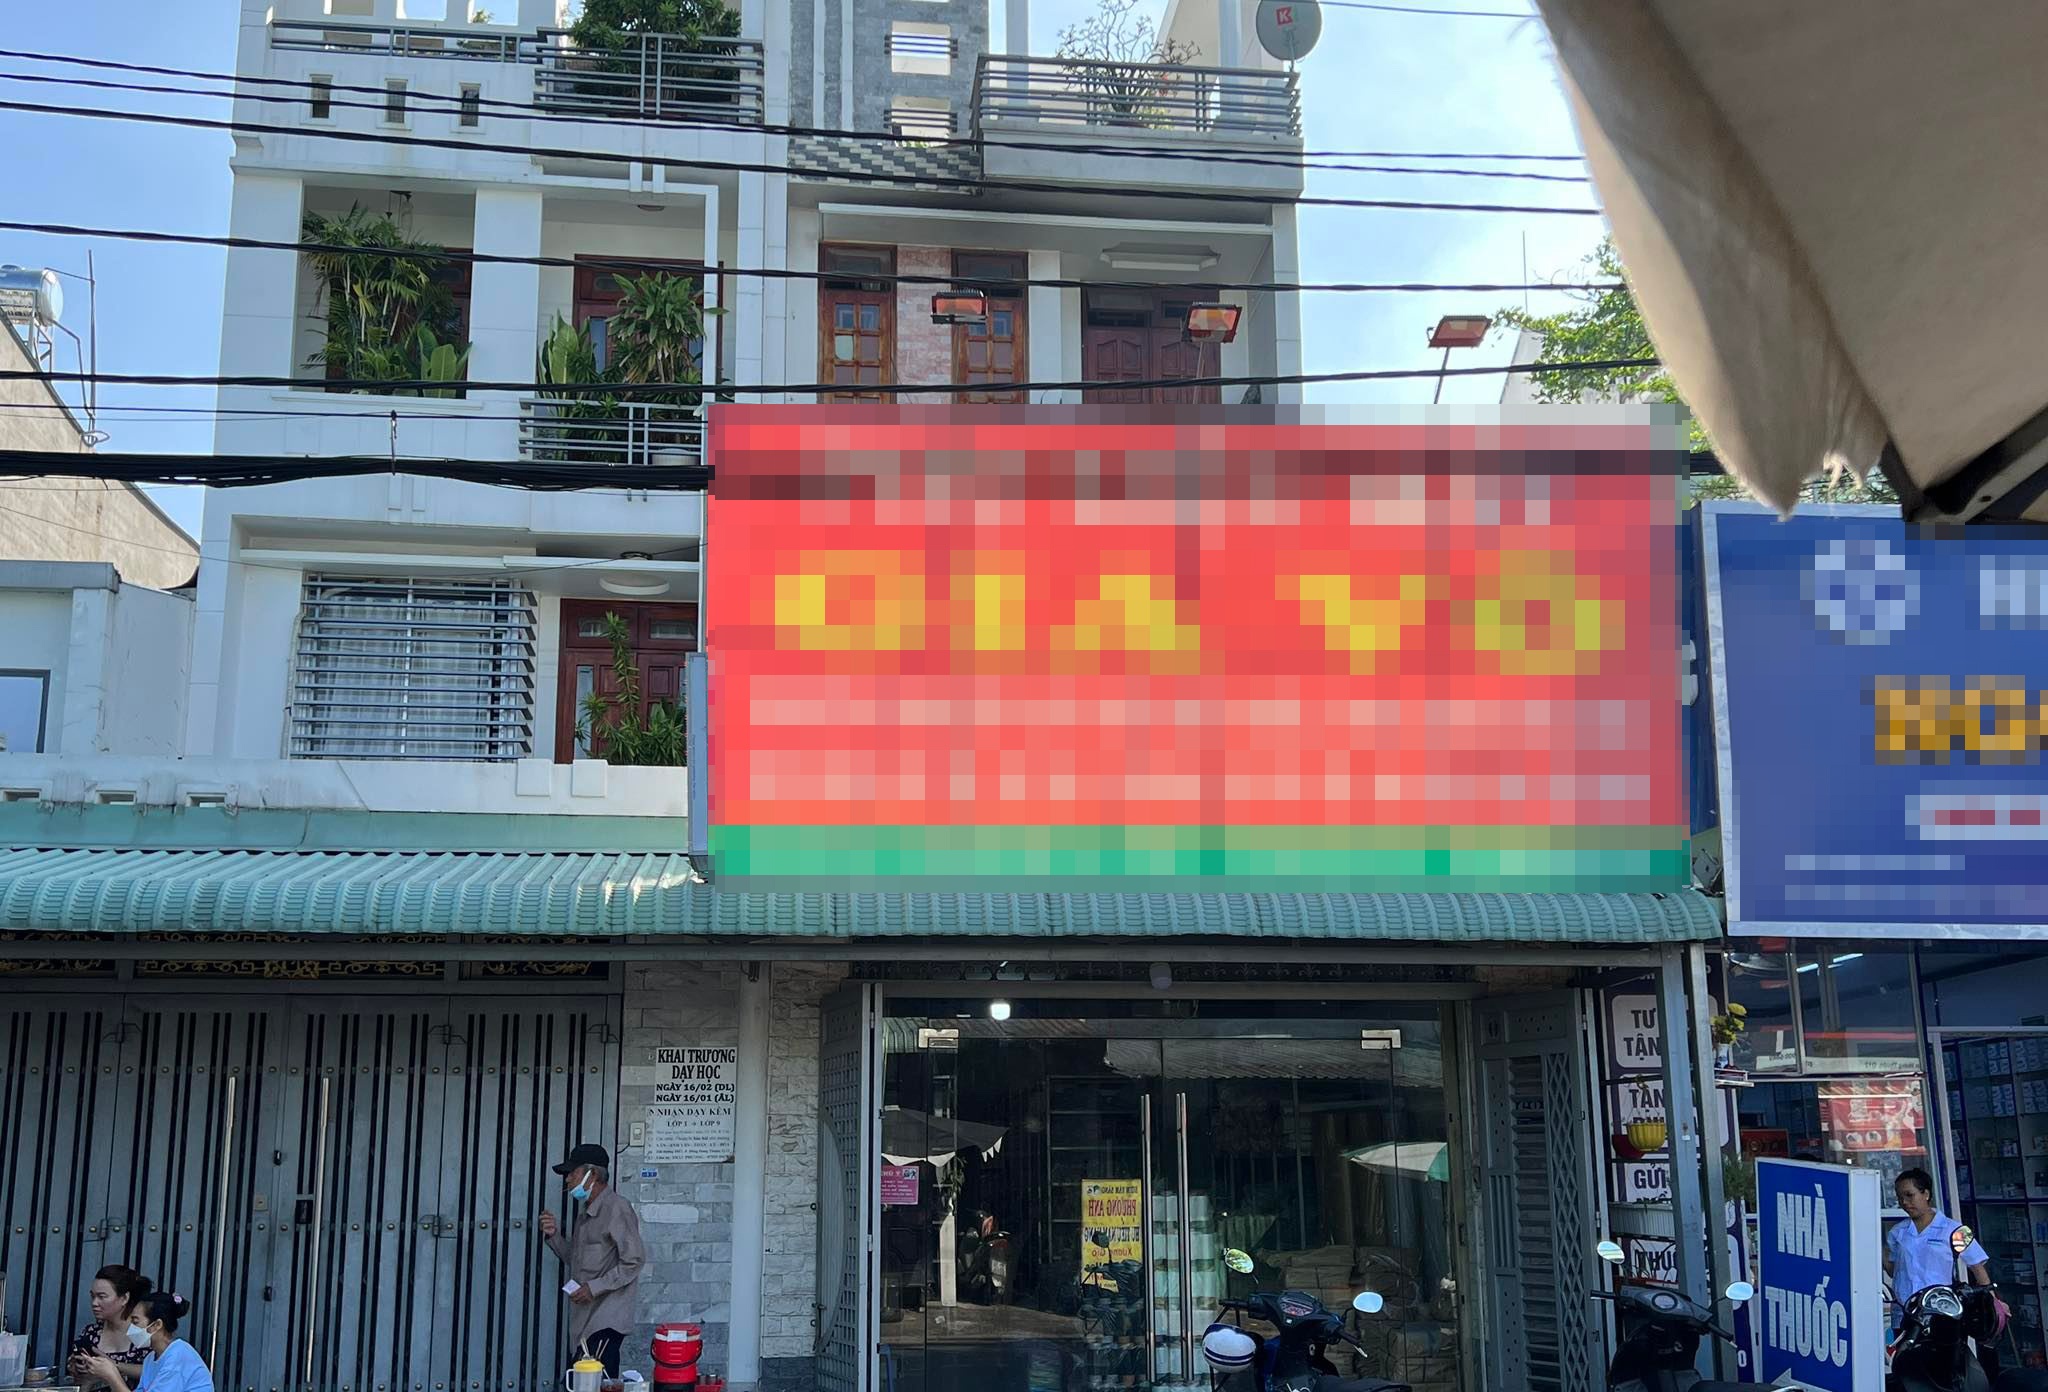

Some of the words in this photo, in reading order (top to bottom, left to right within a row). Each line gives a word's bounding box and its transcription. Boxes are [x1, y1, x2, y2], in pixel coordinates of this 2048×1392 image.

[1631, 1008, 1657, 1029] TƯ
[658, 1049, 685, 1063] KHAI
[687, 1048, 735, 1063] TRƯƠNG
[672, 1065, 695, 1082] DẠY
[696, 1065, 721, 1082] HỌC
[656, 1082, 682, 1091] NGÀY
[684, 1083, 713, 1092] 16/02
[656, 1093, 682, 1102] NGÀY
[684, 1094, 712, 1103] 16/01
[1776, 1183, 1831, 1262] NHÀ
[1765, 1275, 1848, 1368] THUỐC
